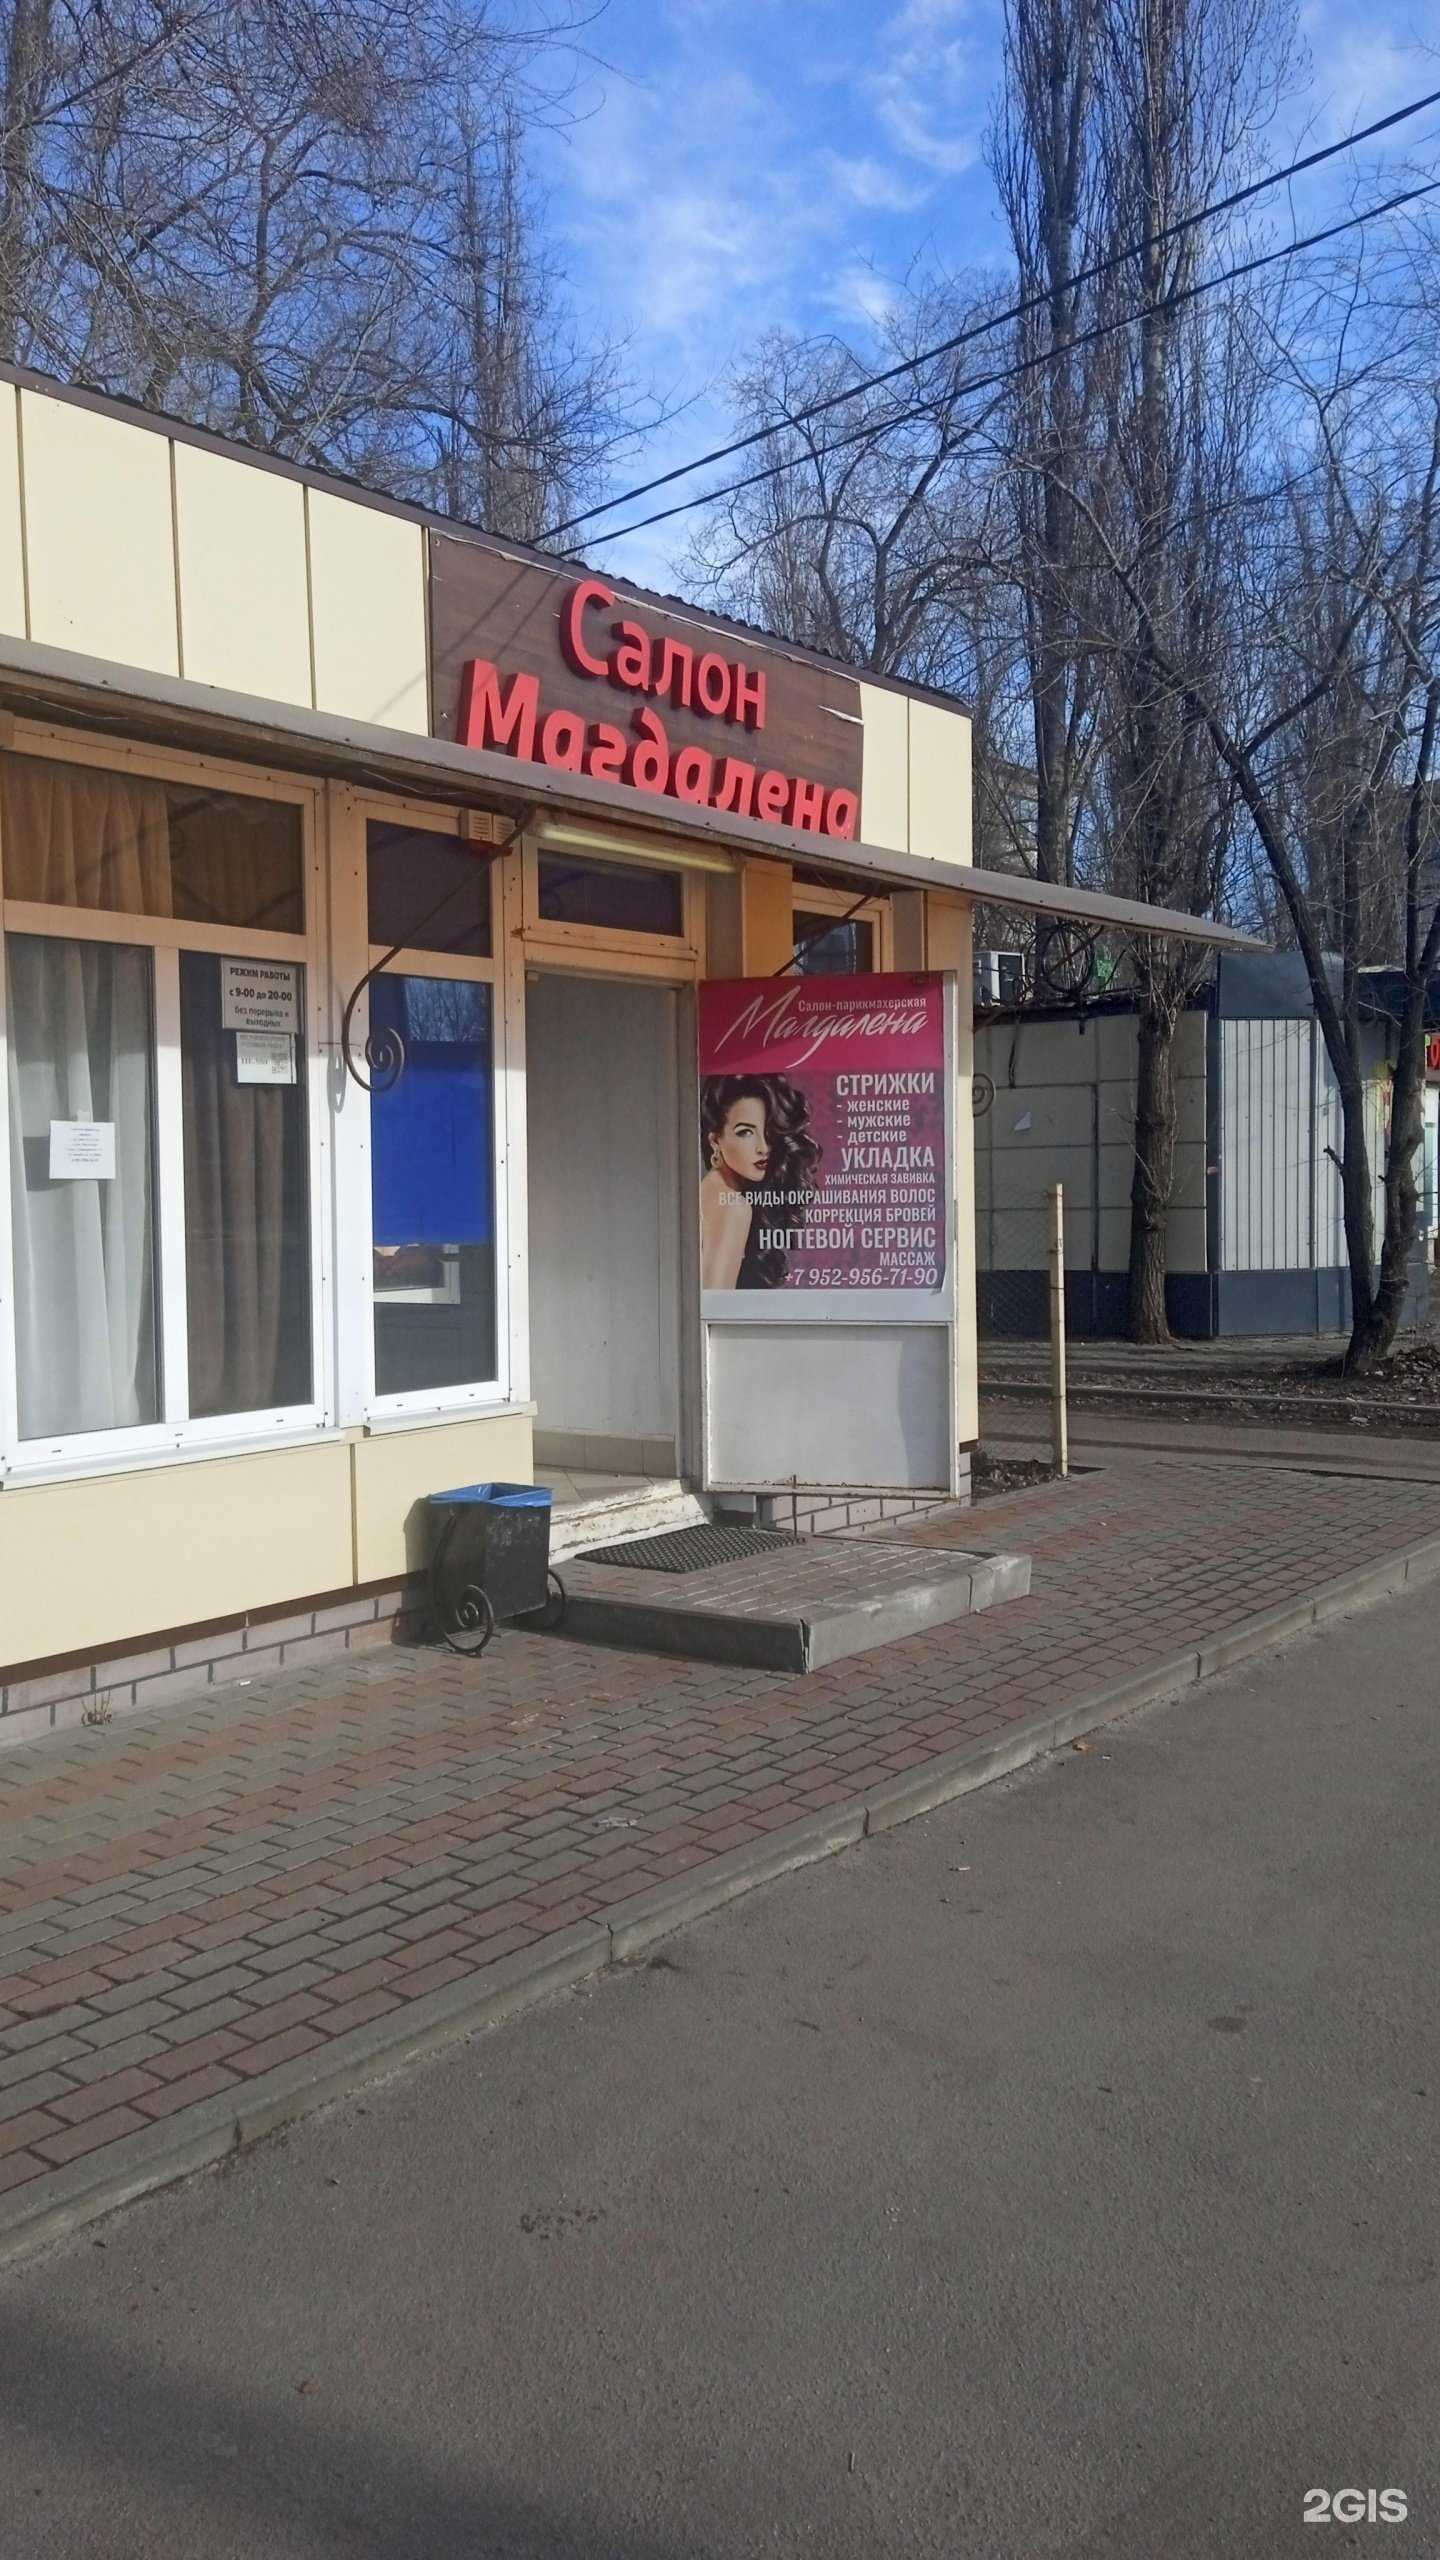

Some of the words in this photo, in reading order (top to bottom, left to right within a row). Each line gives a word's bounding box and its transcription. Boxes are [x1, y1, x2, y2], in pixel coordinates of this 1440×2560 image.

[560, 579, 767, 730] Салон
[460, 658, 859, 842] Магдалена
[235, 987, 255, 998] 9-00
[798, 997, 927, 1012] Салон-парикмахерская
[714, 985, 928, 1069] Магдалена
[836, 1072, 935, 1096] СТРИЖКИ
[847, 1099, 910, 1113] женские
[847, 1114, 911, 1128] мужские
[847, 1129, 907, 1145] детские
[841, 1146, 935, 1171] УКЛАДКА
[824, 1174, 888, 1186] ХИМИЧЕСКАЯ
[890, 1173, 935, 1184] ЗАВИВКА
[745, 1191, 784, 1208] ВИДЫ
[788, 1189, 886, 1205] ОКРАШИВАНИЯ
[890, 1188, 936, 1203] ВОЛОС
[805, 1207, 882, 1225] КОРРЕКЦИЯ
[886, 1204, 936, 1222] БРОВЕЙ
[759, 1223, 854, 1250] НОГТЕВОЙ
[861, 1227, 936, 1249] СЕРВИС
[879, 1251, 936, 1266] МАССАЖ
[784, 1269, 804, 1286] +7
[808, 1267, 938, 1286] 952-956-71-90
